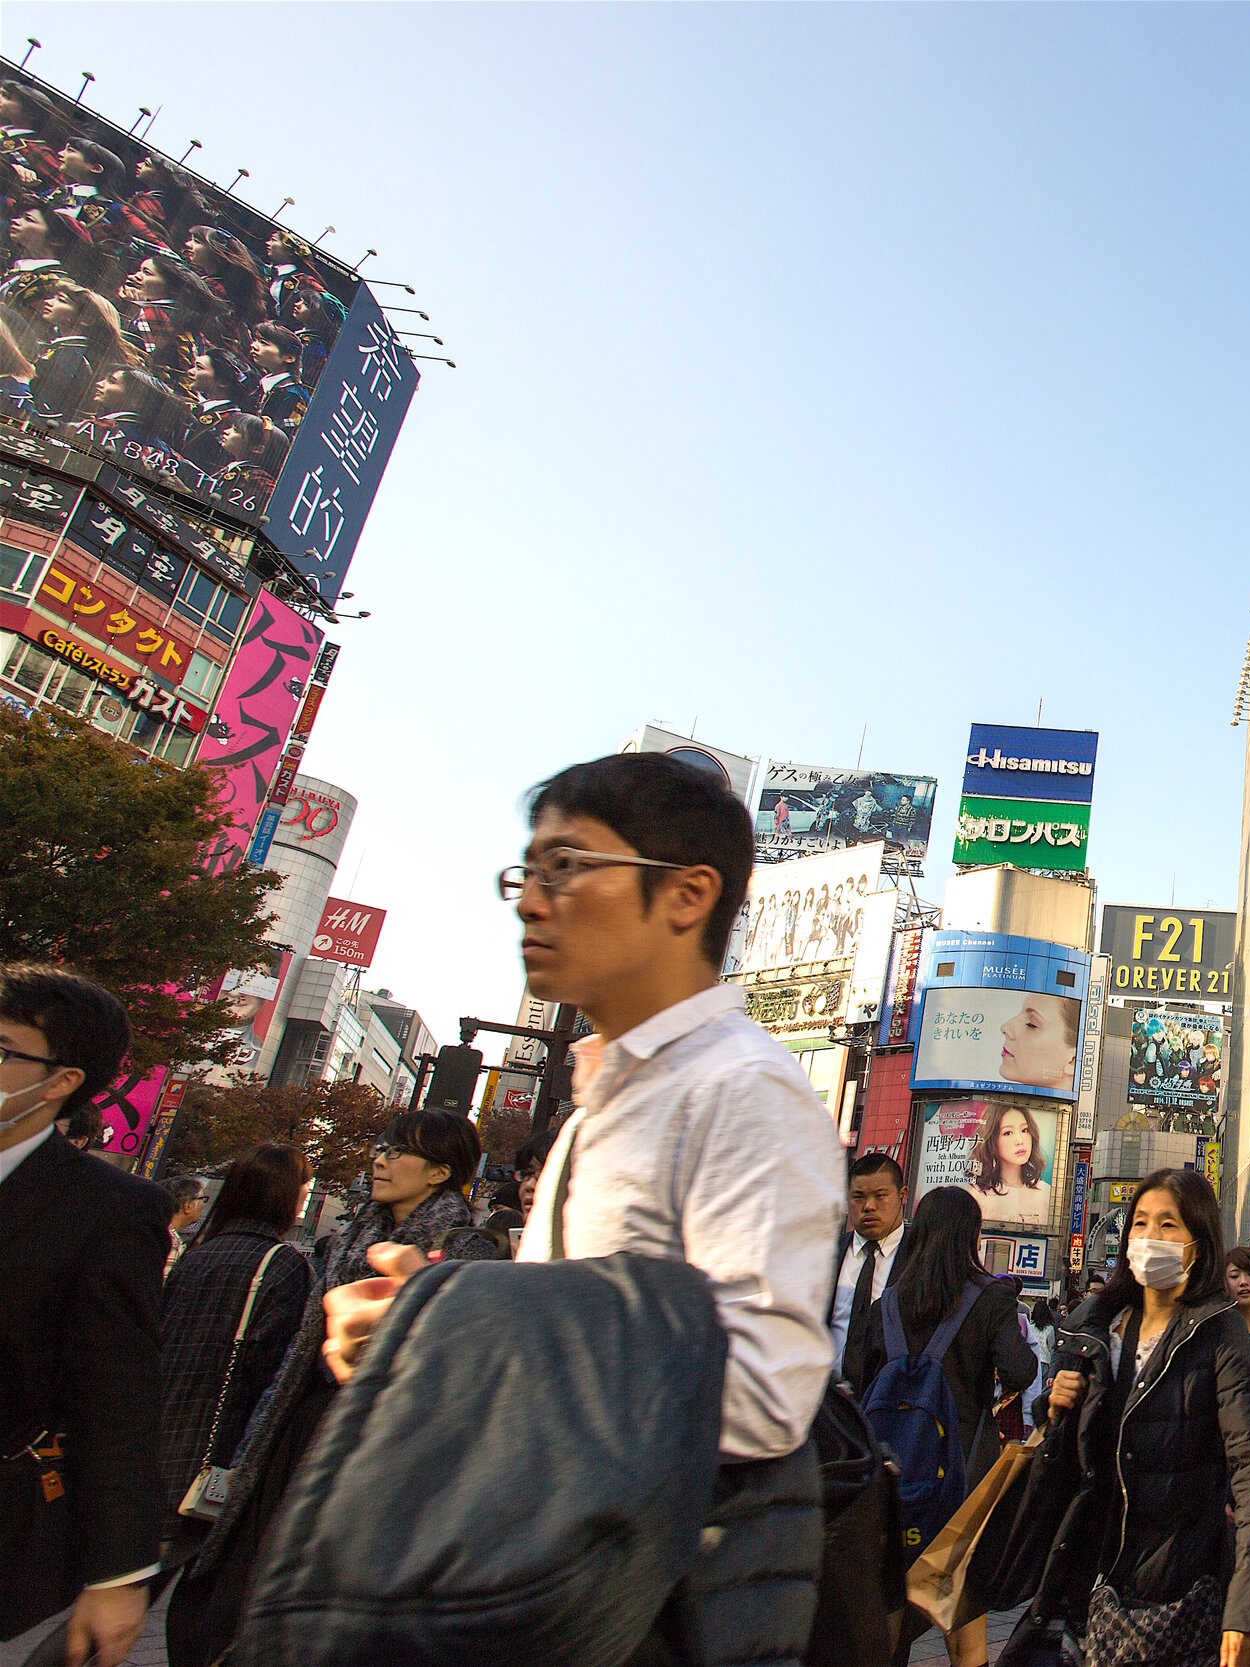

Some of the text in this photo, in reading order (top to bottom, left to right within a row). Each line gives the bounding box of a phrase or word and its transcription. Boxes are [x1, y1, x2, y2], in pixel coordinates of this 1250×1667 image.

[77, 421, 180, 476] AKB48
[228, 488, 256, 511] 26
[98, 501, 112, 515] 9F
[41, 567, 183, 667] コンタクト
[128, 678, 193, 725] ガスト
[967, 747, 1092, 776] Hisamitsu
[324, 906, 372, 936] H&M
[333, 945, 365, 960] 150m
[336, 937, 360, 949] この先
[1132, 914, 1204, 963] F21
[1109, 965, 1230, 994] OREVER 21
[514, 999, 545, 1062] Essnti
[934, 1011, 985, 1025] あなたの
[932, 1027, 983, 1041] きれいを
[926, 1134, 984, 1153] 西野カナ
[926, 1161, 947, 1173] with
[1072, 1167, 1087, 1229] 大盛堂商事ビル
[1016, 1243, 1040, 1269] 店
